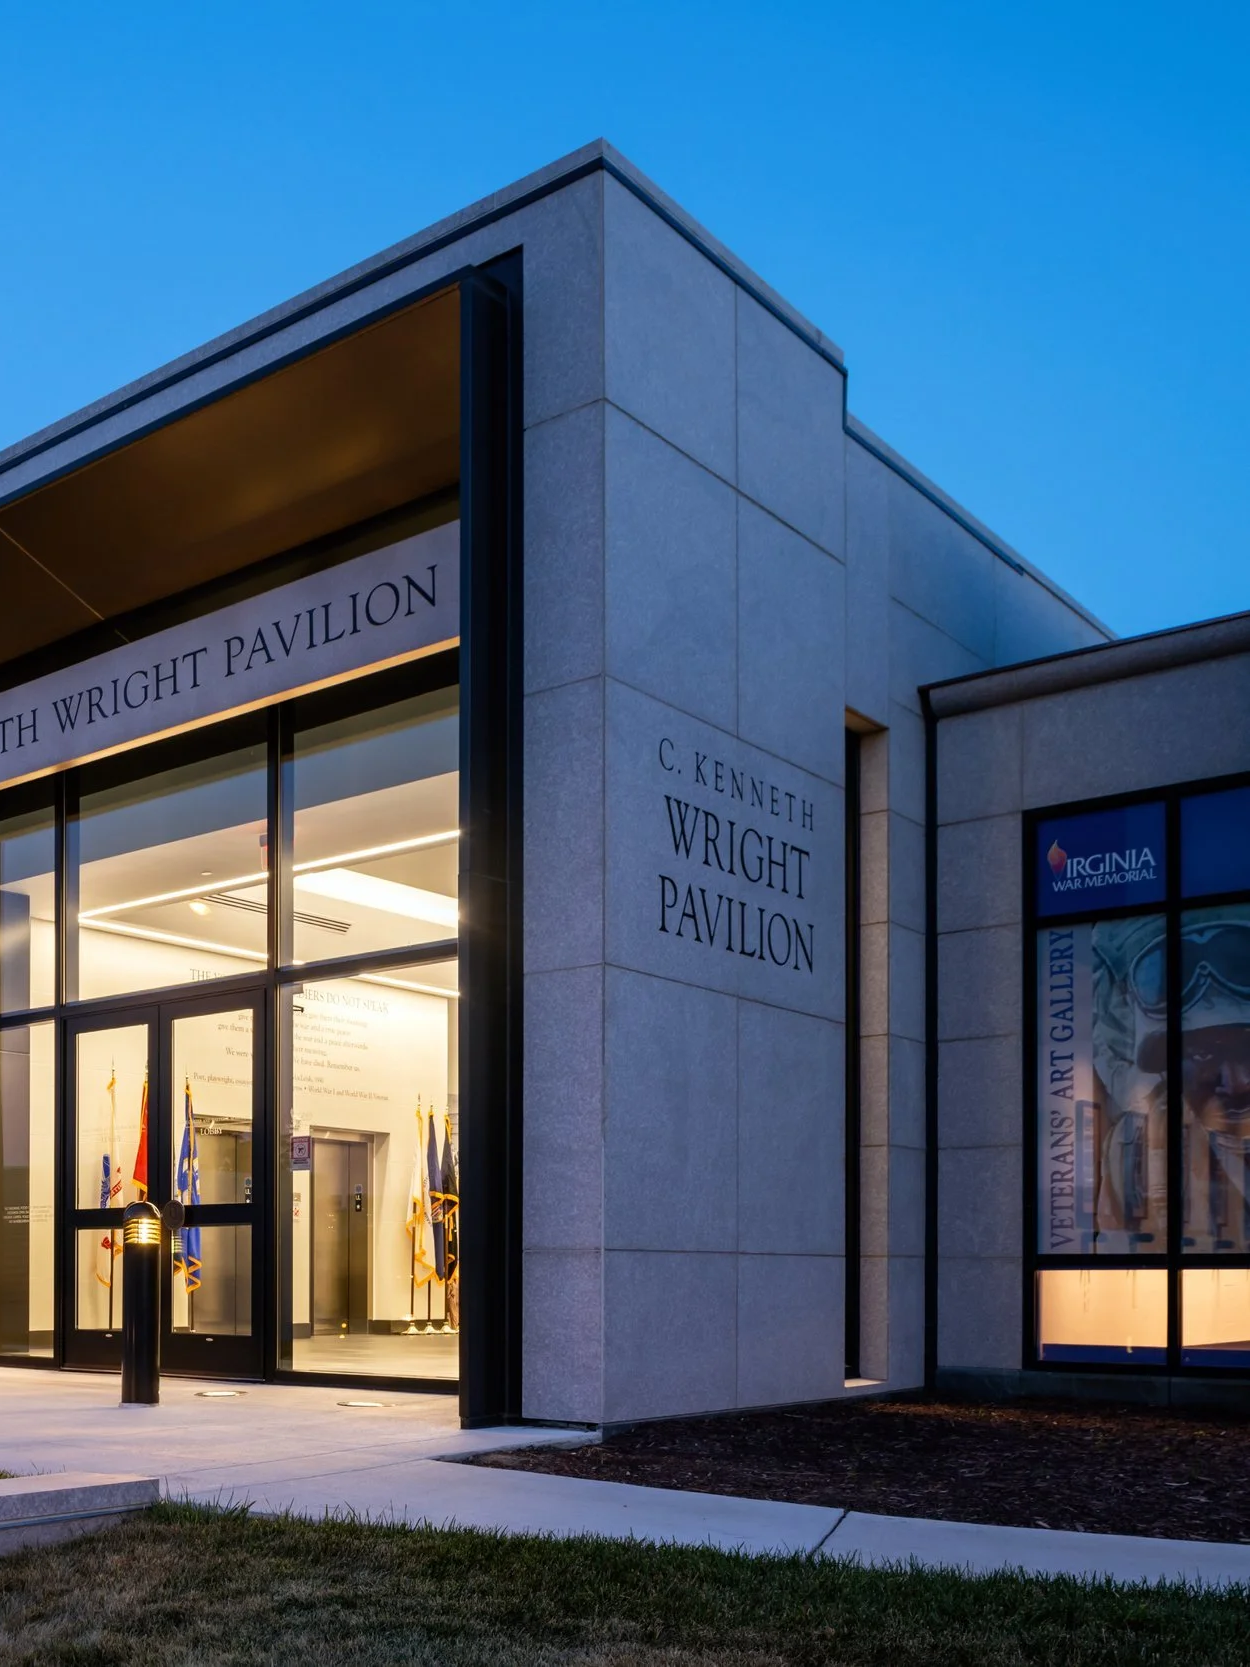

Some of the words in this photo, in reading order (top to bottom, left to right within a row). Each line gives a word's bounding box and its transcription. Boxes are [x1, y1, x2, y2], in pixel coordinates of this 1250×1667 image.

[52, 647, 208, 735] WRIGHT
[223, 564, 439, 678] PAVILION
[658, 737, 682, 776] C.
[694, 751, 814, 833] KENNETH
[663, 794, 811, 900] WRIGHT
[1052, 877, 1083, 893] WAR
[1084, 867, 1158, 889] MEMORIAL
[658, 873, 814, 975] PAVILION
[189, 968, 211, 981] THE
[326, 991, 340, 1004] DO
[342, 992, 361, 1009] NOT
[363, 999, 389, 1015] SPEAK
[1050, 929, 1075, 1044] GALLERY
[1050, 1049, 1075, 1101] ART
[200, 1127, 223, 1137] LOBBY
[1050, 1109, 1075, 1249] VETERANS'
